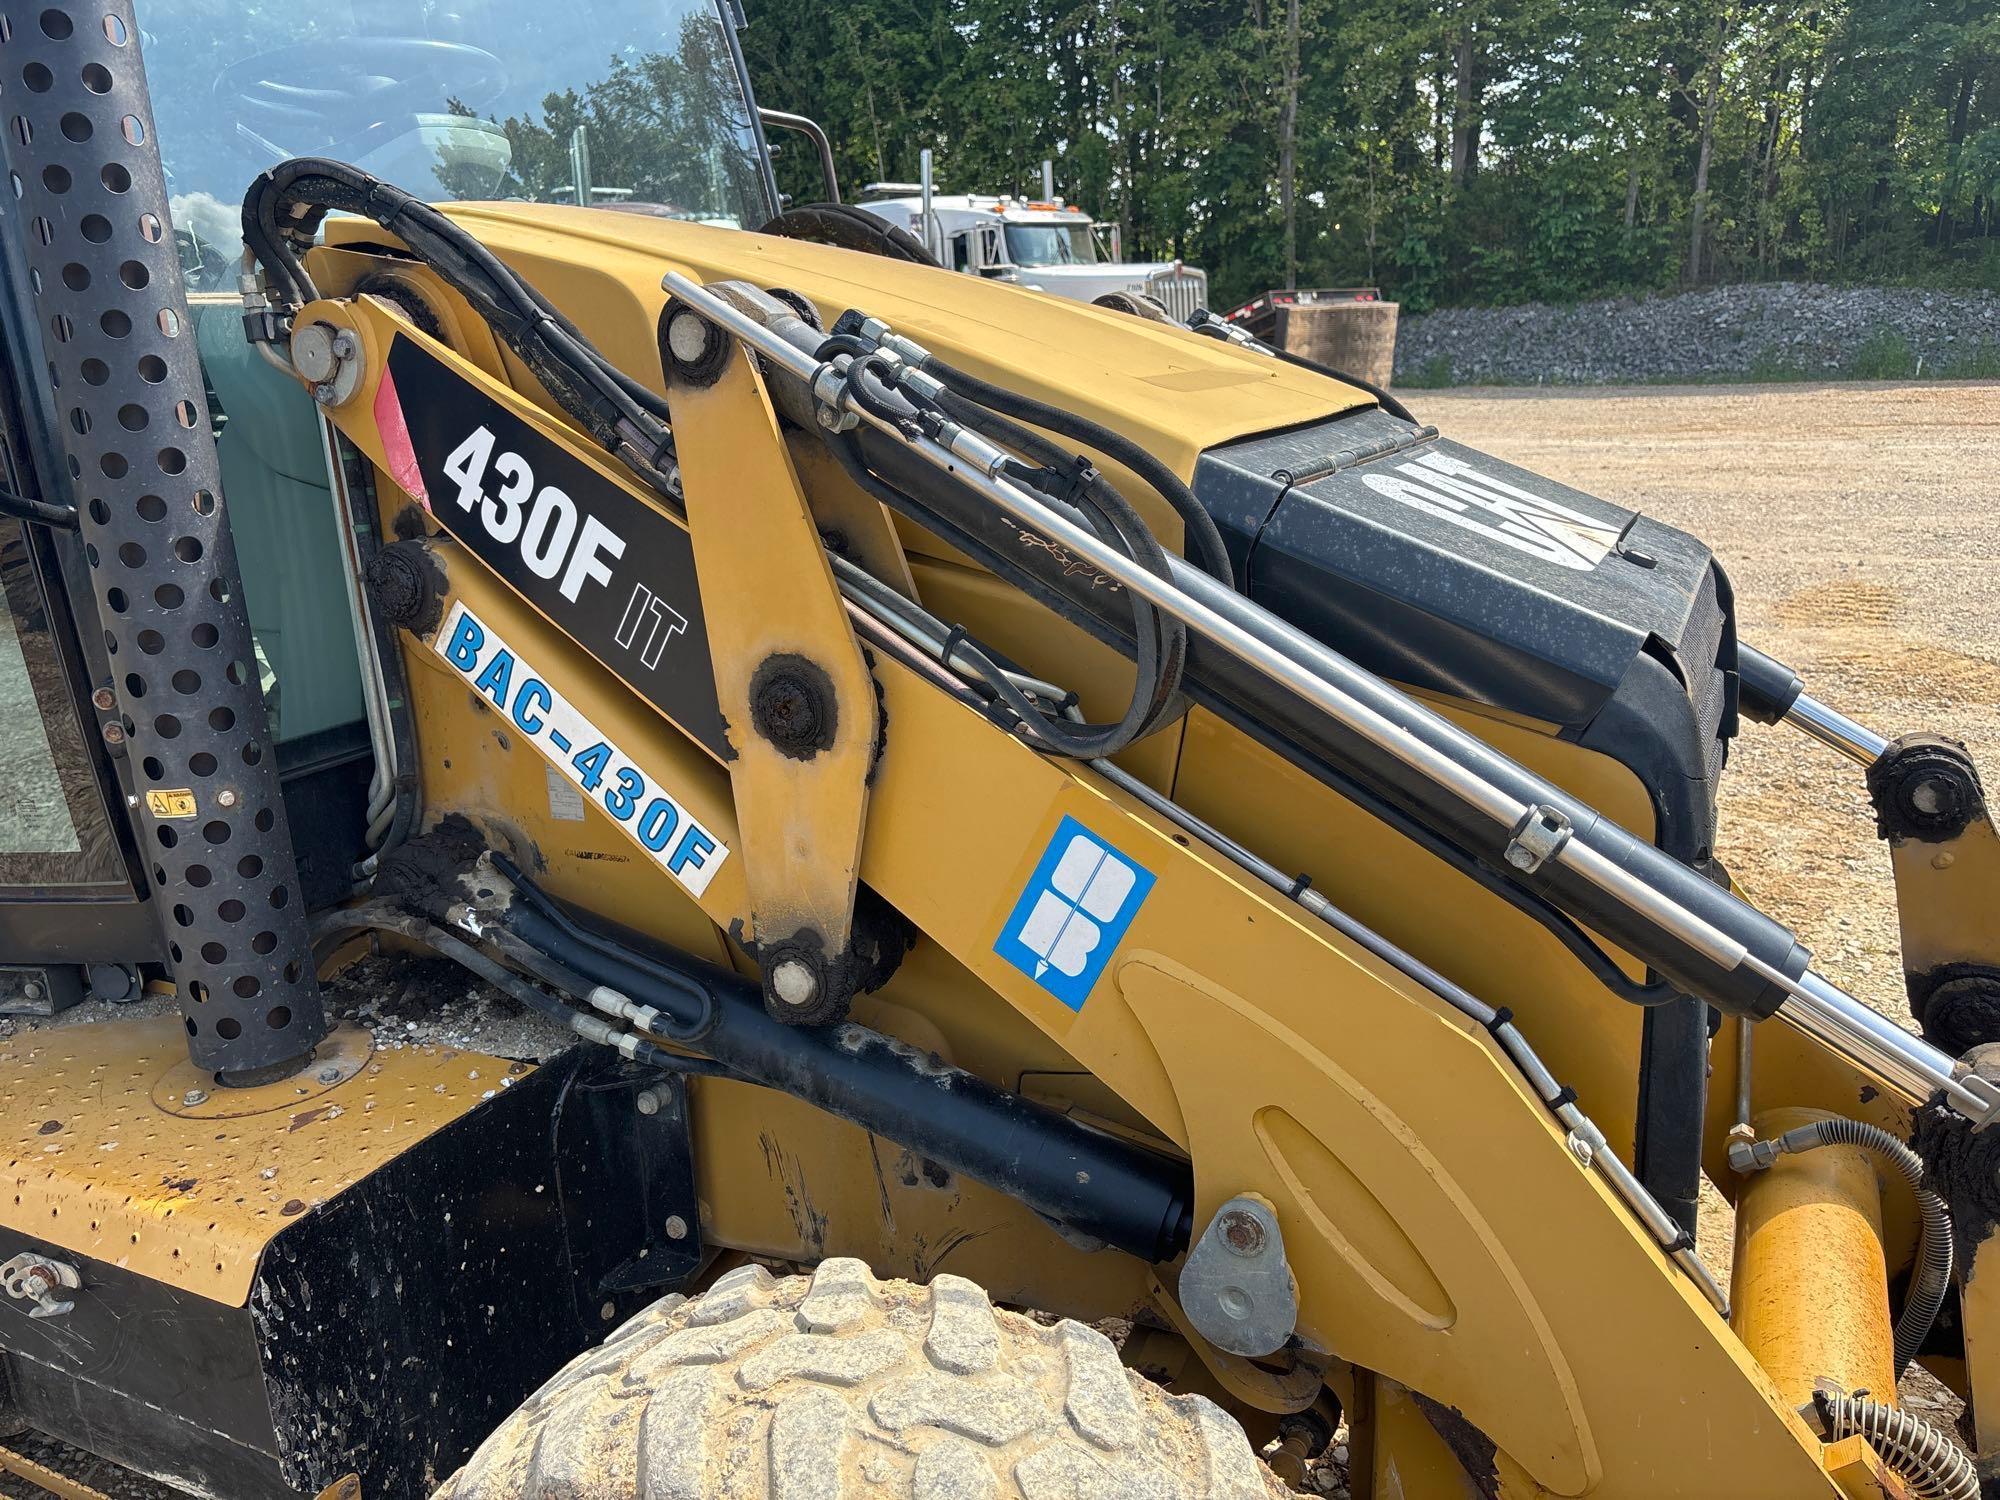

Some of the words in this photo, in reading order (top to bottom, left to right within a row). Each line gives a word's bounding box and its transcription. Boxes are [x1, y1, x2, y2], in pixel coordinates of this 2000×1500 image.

[443, 425, 627, 604] 430F
[614, 582, 689, 671] IT
[444, 610, 717, 876] BAC-430F
